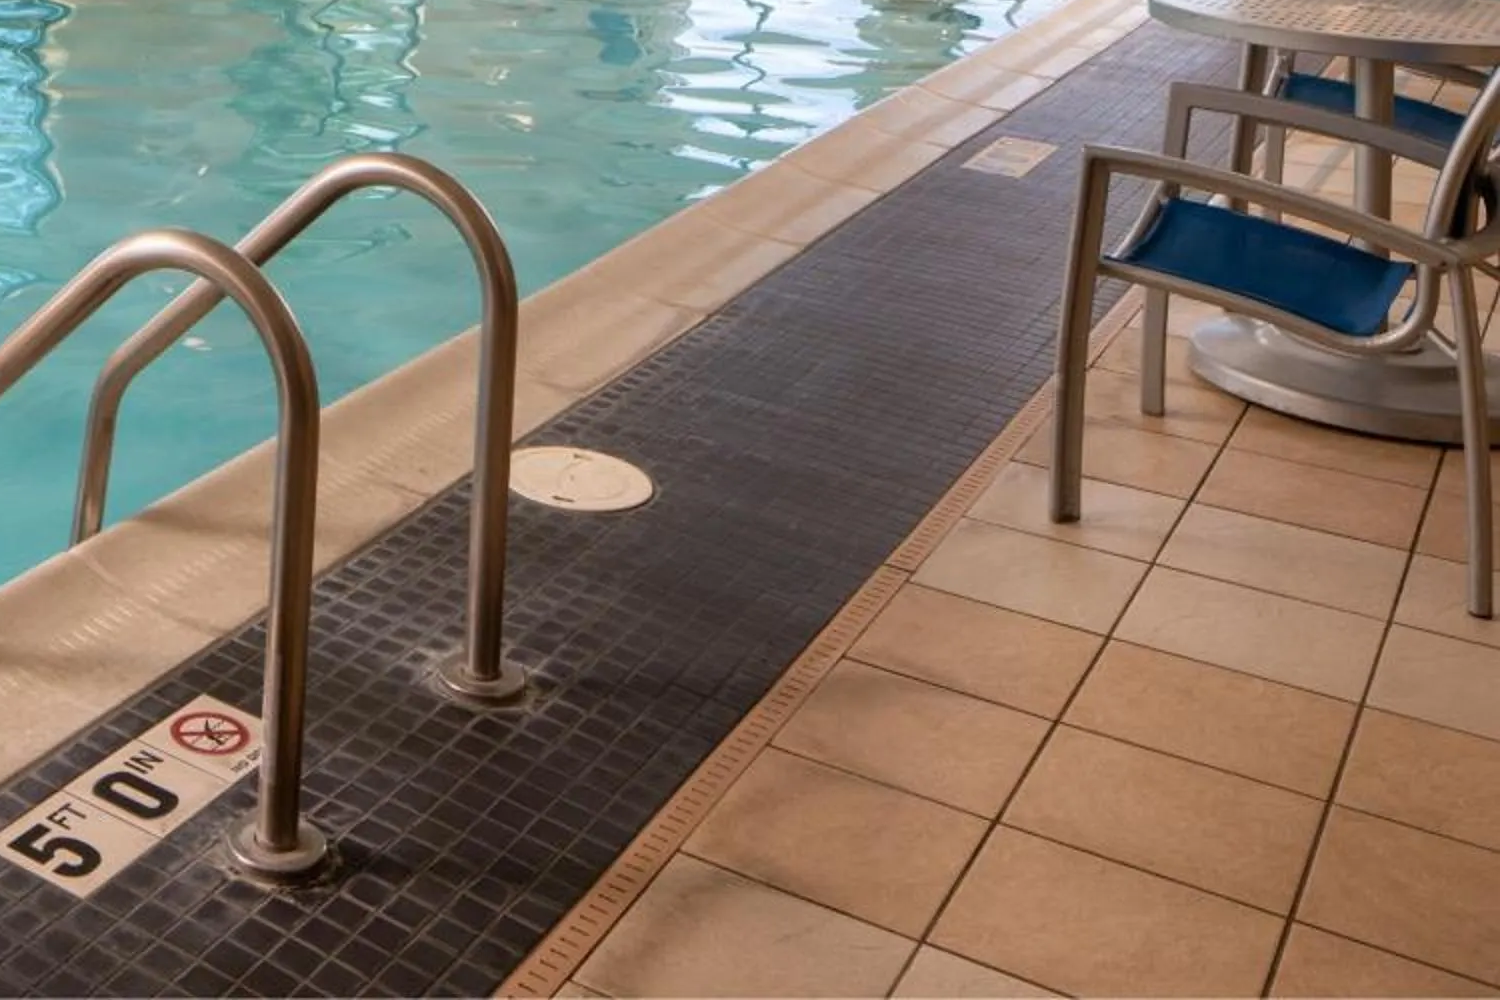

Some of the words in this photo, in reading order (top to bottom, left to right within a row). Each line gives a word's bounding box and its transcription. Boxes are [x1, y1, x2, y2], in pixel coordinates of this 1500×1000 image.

[123, 750, 165, 774] IN
[92, 771, 180, 820] 0
[46, 801, 87, 831] FT
[7, 823, 102, 878] 5
